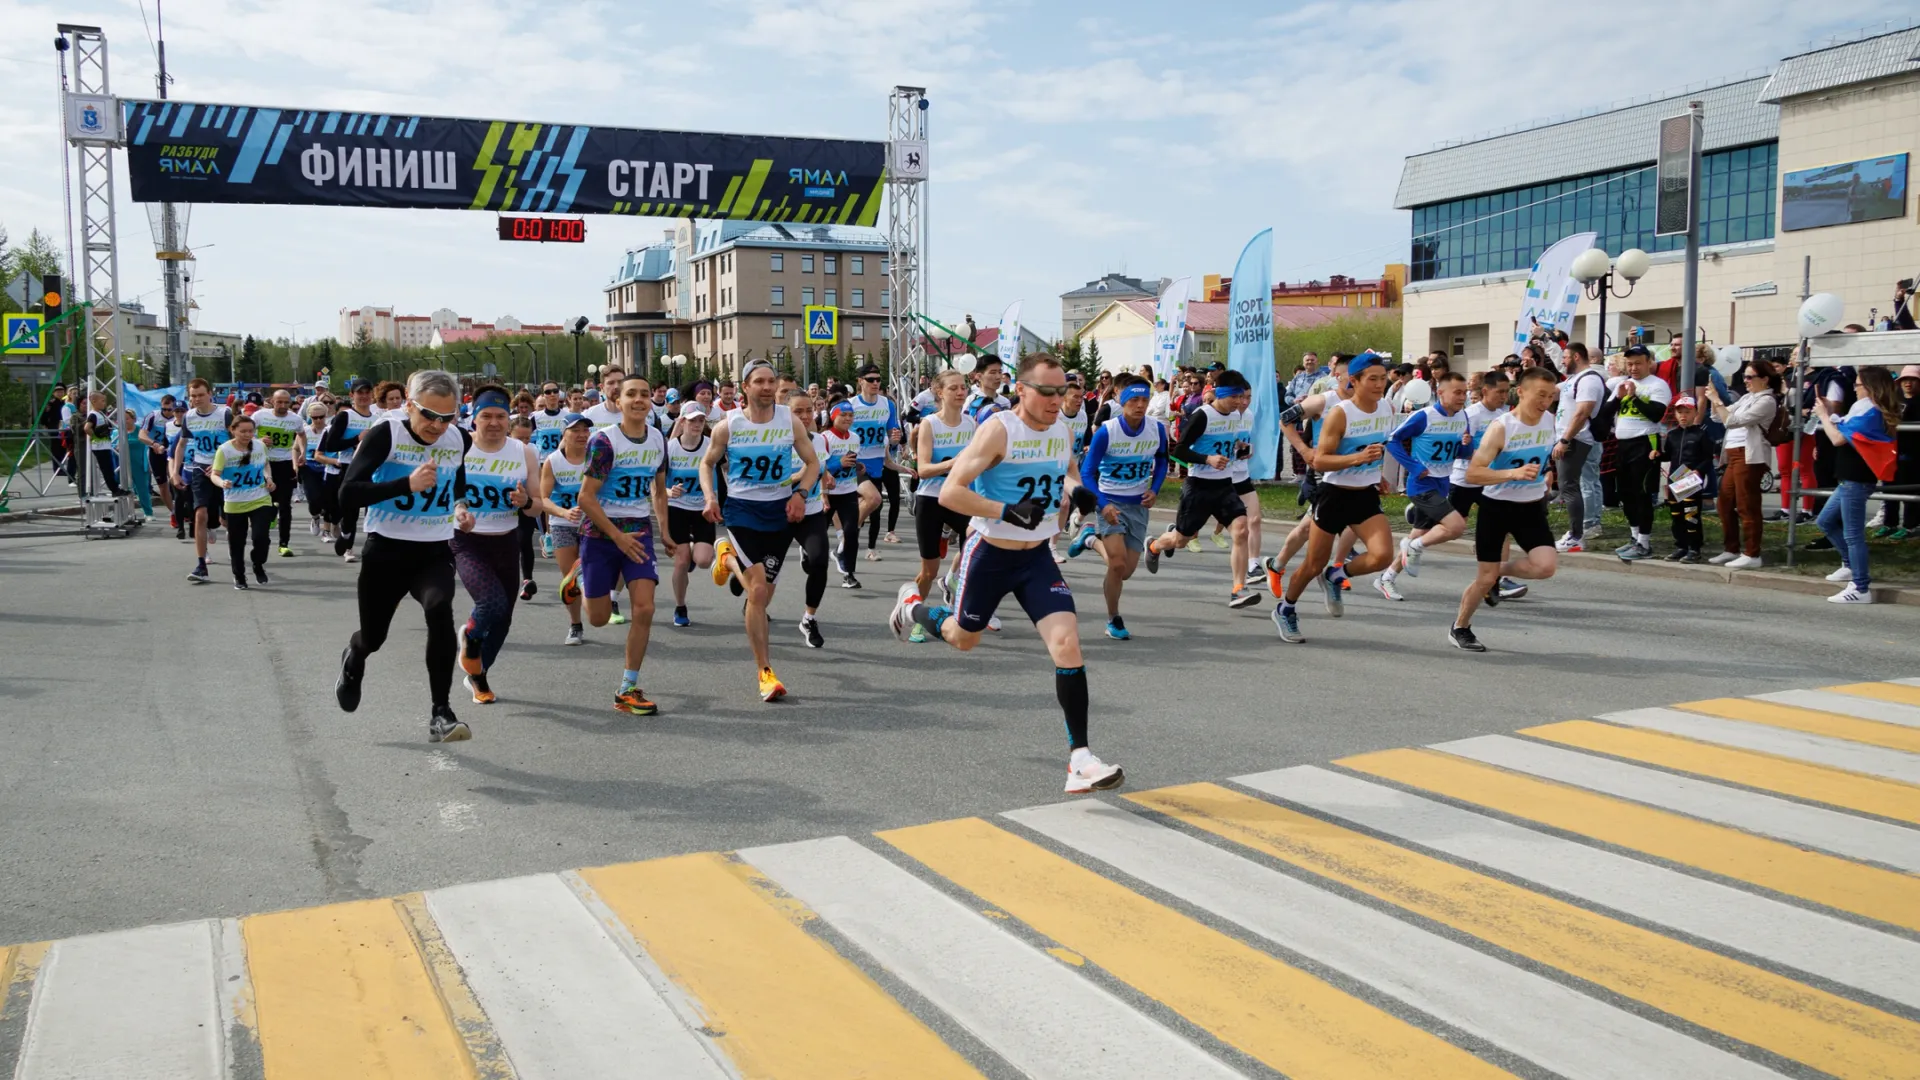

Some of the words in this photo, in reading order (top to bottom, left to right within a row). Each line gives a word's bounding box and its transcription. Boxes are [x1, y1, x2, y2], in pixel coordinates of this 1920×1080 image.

[160, 144, 219, 160] РАЗБУДИ
[159, 158, 220, 175] ЯМАЛ
[301, 143, 457, 190] ФИНИШ
[607, 159, 714, 200] СТАРТ
[789, 167, 849, 186] ЯМАЛ
[542, 434, 563, 450] 35
[857, 427, 885, 444] 398
[740, 455, 783, 481] 296
